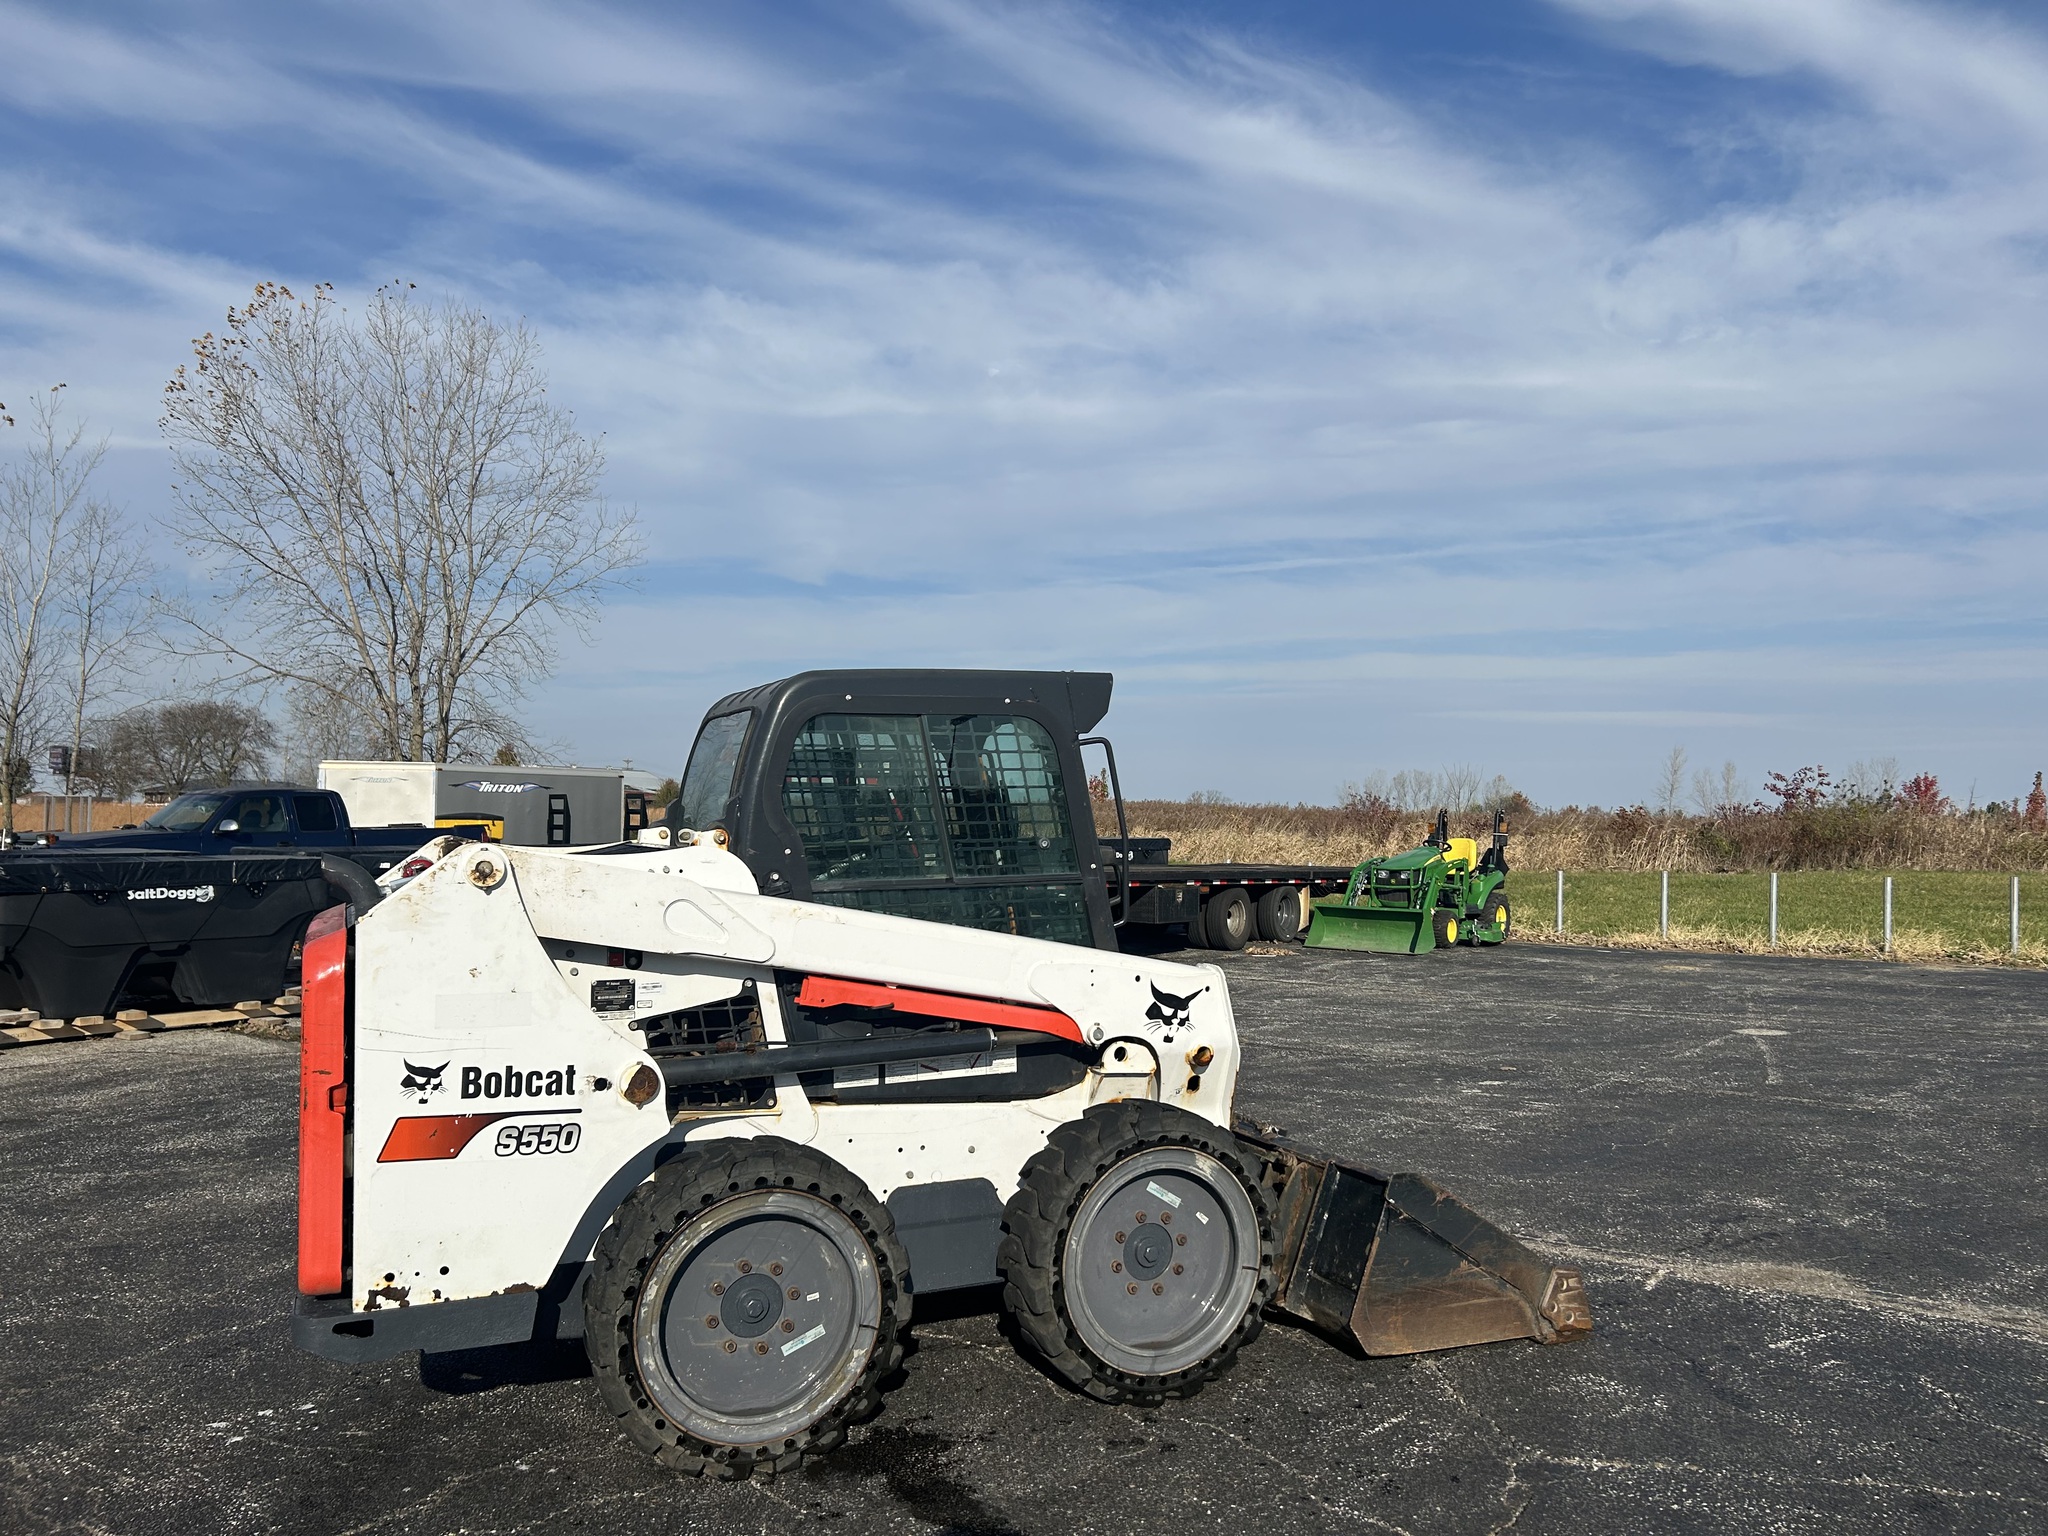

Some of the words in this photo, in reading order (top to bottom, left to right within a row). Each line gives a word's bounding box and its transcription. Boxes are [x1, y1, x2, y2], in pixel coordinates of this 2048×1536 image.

[478, 781, 524, 793] TRITON
[127, 887, 196, 900] SaltDogg
[461, 1065, 576, 1099] Bobcat
[494, 1122, 581, 1157] S550
